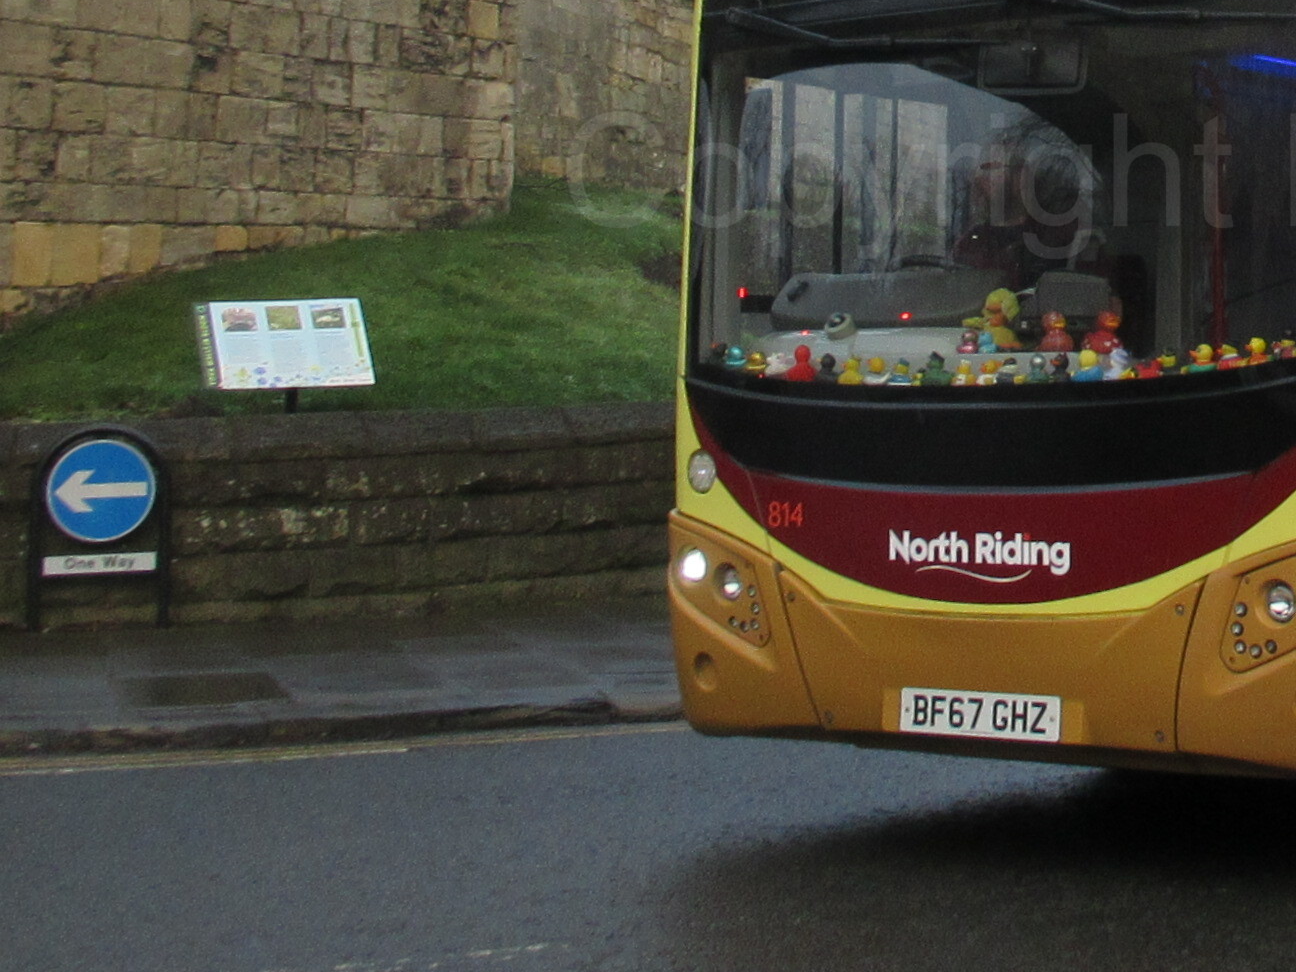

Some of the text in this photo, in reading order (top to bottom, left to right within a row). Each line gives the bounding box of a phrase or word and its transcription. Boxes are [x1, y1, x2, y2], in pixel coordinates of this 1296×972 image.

[768, 501, 805, 527] 814
[63, 555, 136, 571] One Way
[888, 529, 1071, 576] North Riding
[912, 694, 1049, 735] BF67 GHZ
